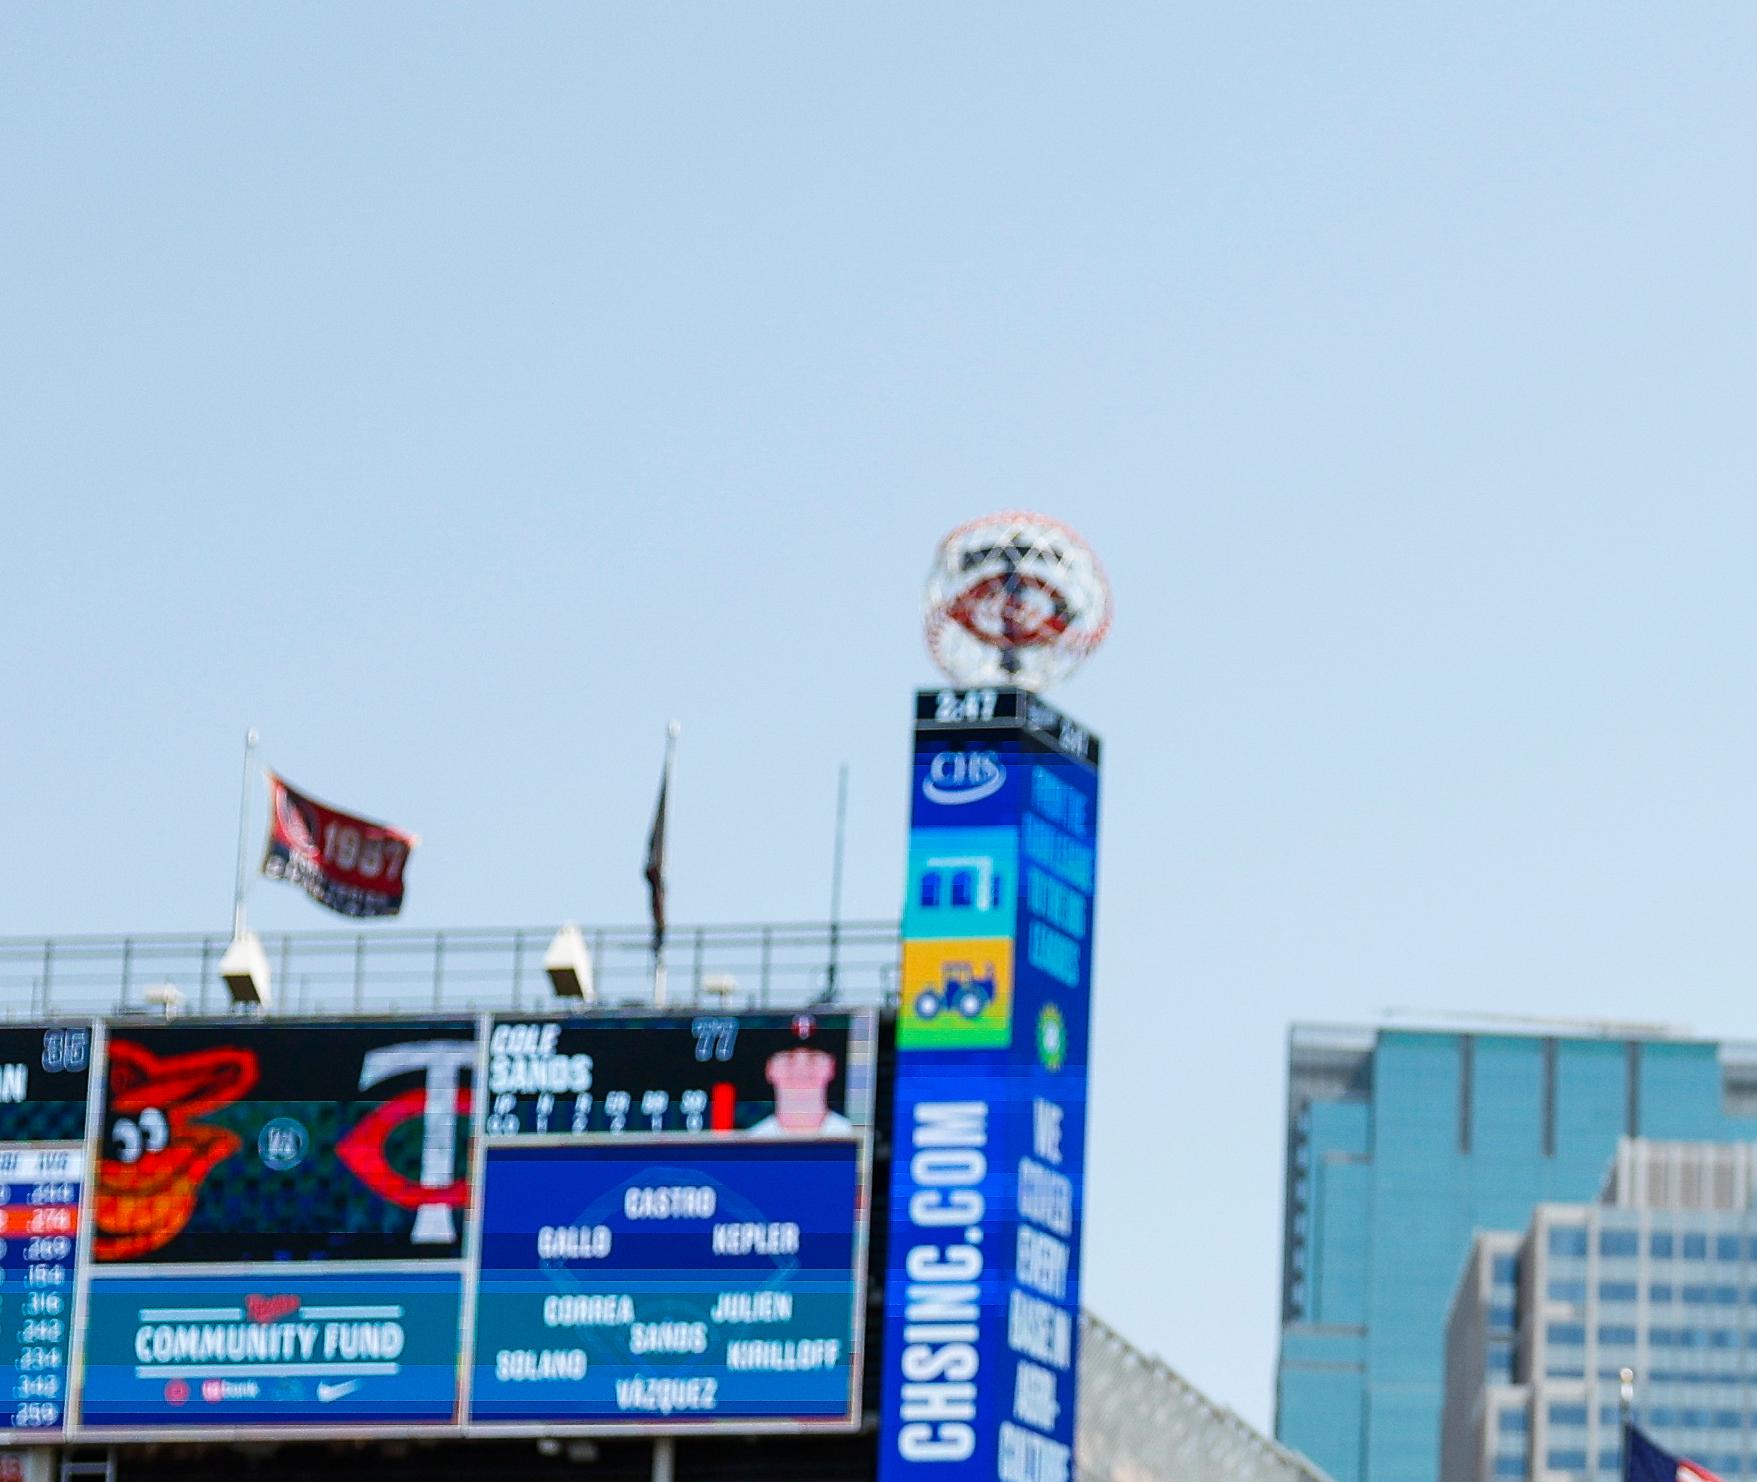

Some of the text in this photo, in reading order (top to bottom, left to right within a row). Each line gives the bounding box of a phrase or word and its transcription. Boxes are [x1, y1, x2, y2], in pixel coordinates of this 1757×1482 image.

[490, 1023, 562, 1055] COLE
[691, 1017, 739, 1062] 77
[489, 1054, 593, 1094] SANDS
[624, 1186, 717, 1219] CASTRO
[538, 1225, 612, 1259] GALLO
[712, 1222, 800, 1256] KEPLER
[898, 1100, 989, 1462] CHSINC.COM
[544, 1294, 635, 1327] CORREA
[711, 1291, 793, 1323] JULIEN
[135, 1321, 405, 1363] COMMUNITY FUND
[629, 1322, 708, 1355] SANDS
[726, 1338, 842, 1371] KIRILLOFF
[495, 1349, 587, 1382] SOLANO
